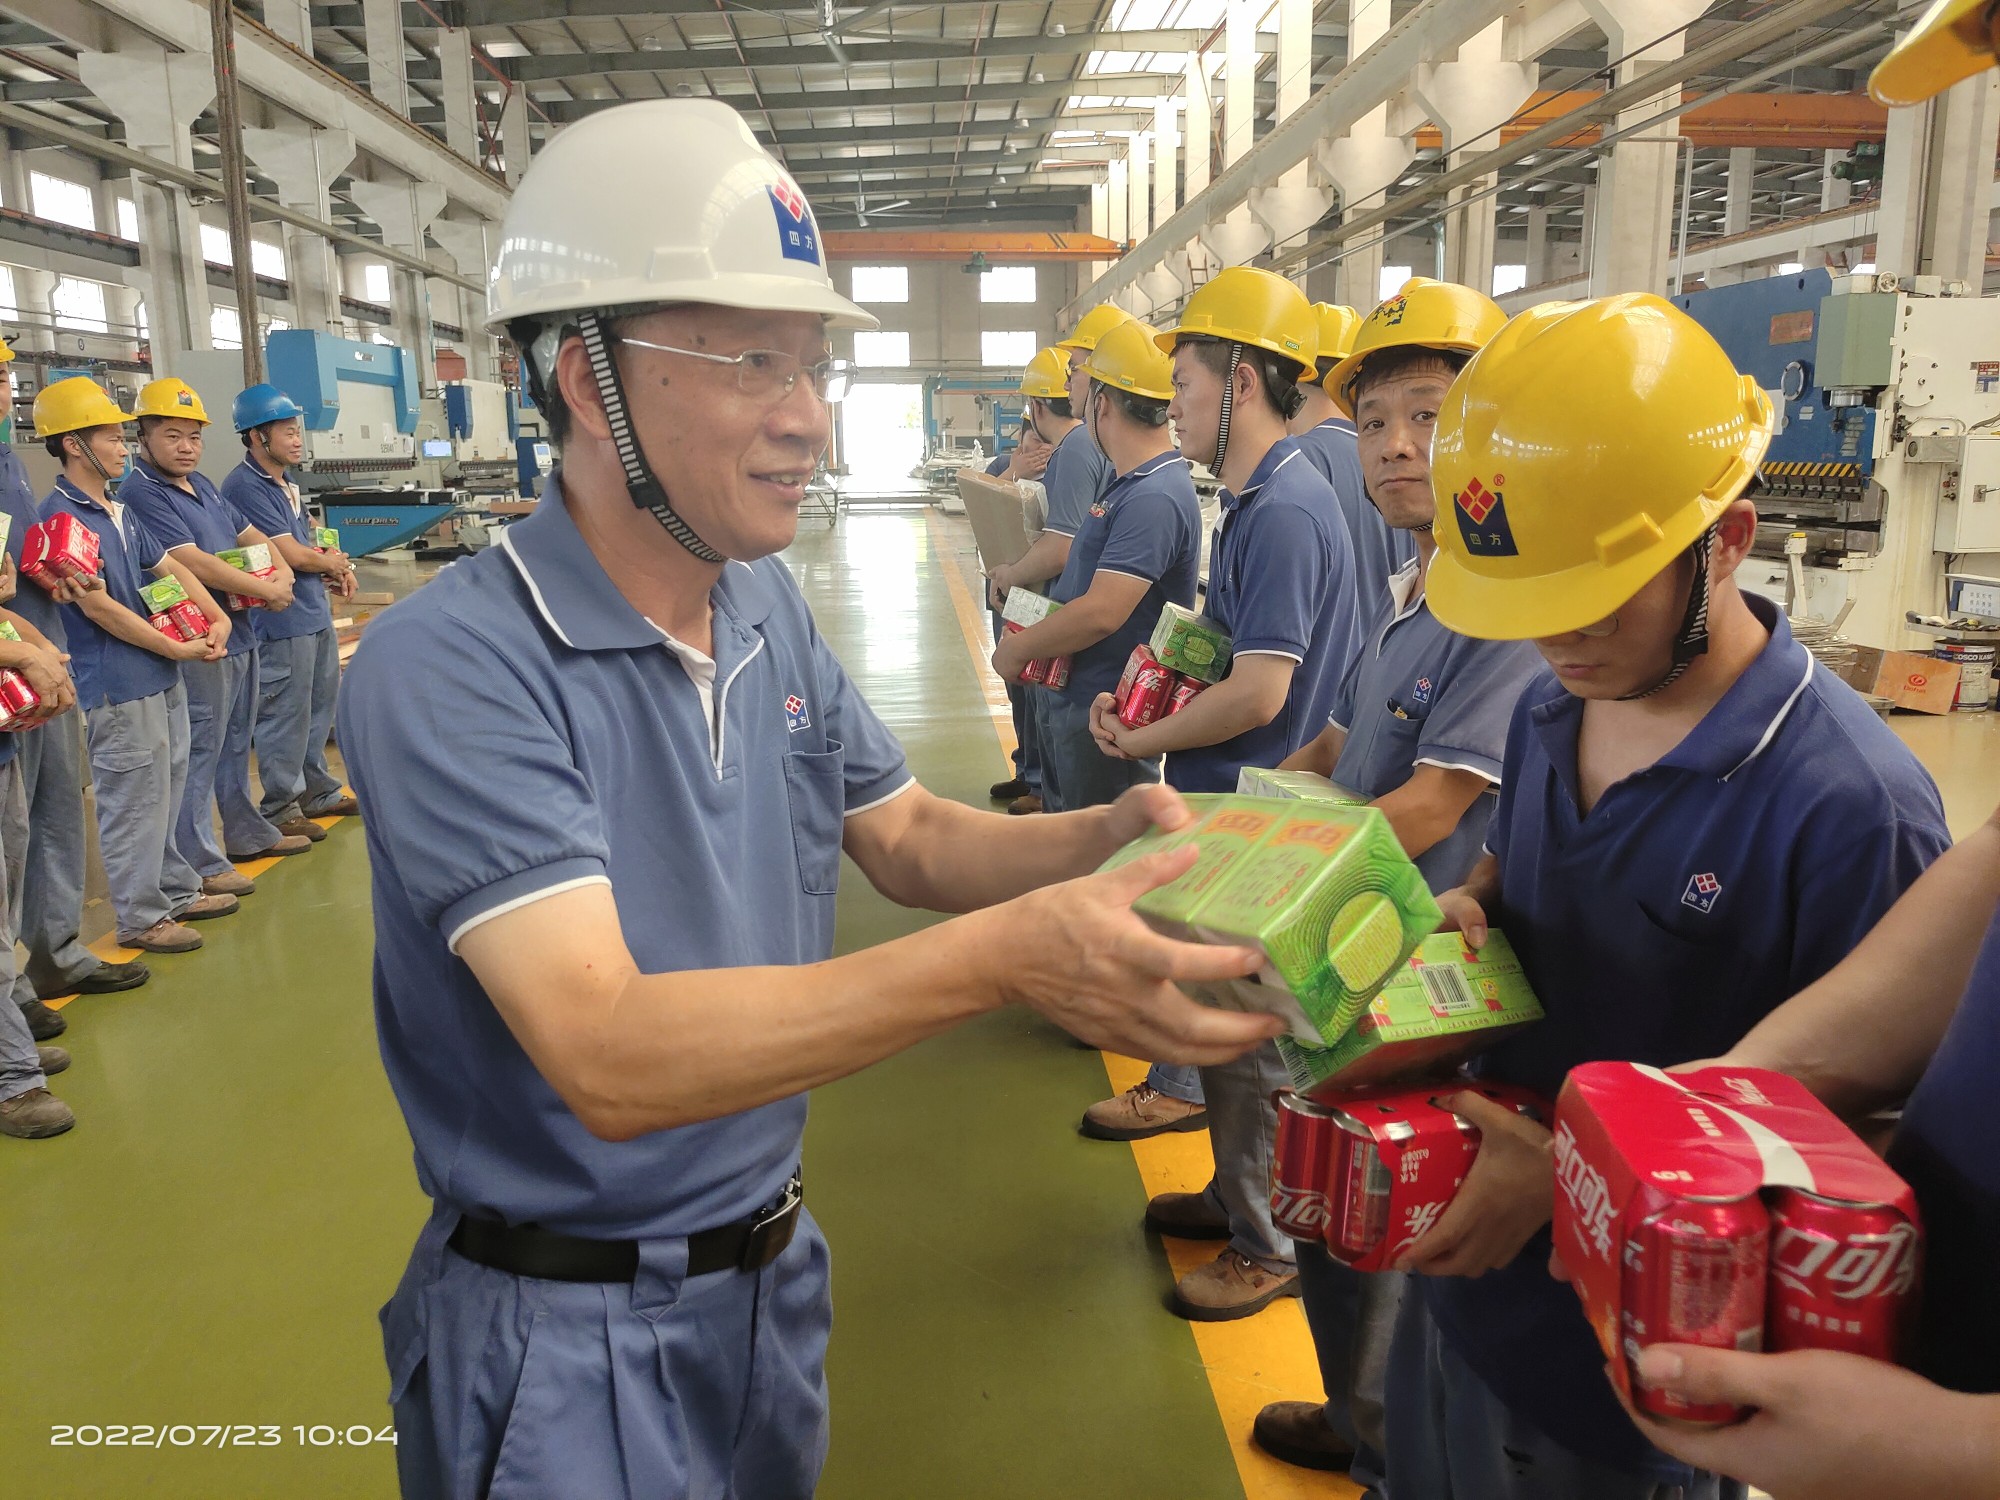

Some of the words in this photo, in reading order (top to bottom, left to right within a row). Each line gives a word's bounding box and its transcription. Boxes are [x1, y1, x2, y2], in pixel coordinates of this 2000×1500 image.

[789, 230, 813, 251] 四方
[1469, 532, 1502, 546] 四方
[1953, 653, 1978, 661] COSCO
[1554, 1119, 1619, 1264] 可口可乐
